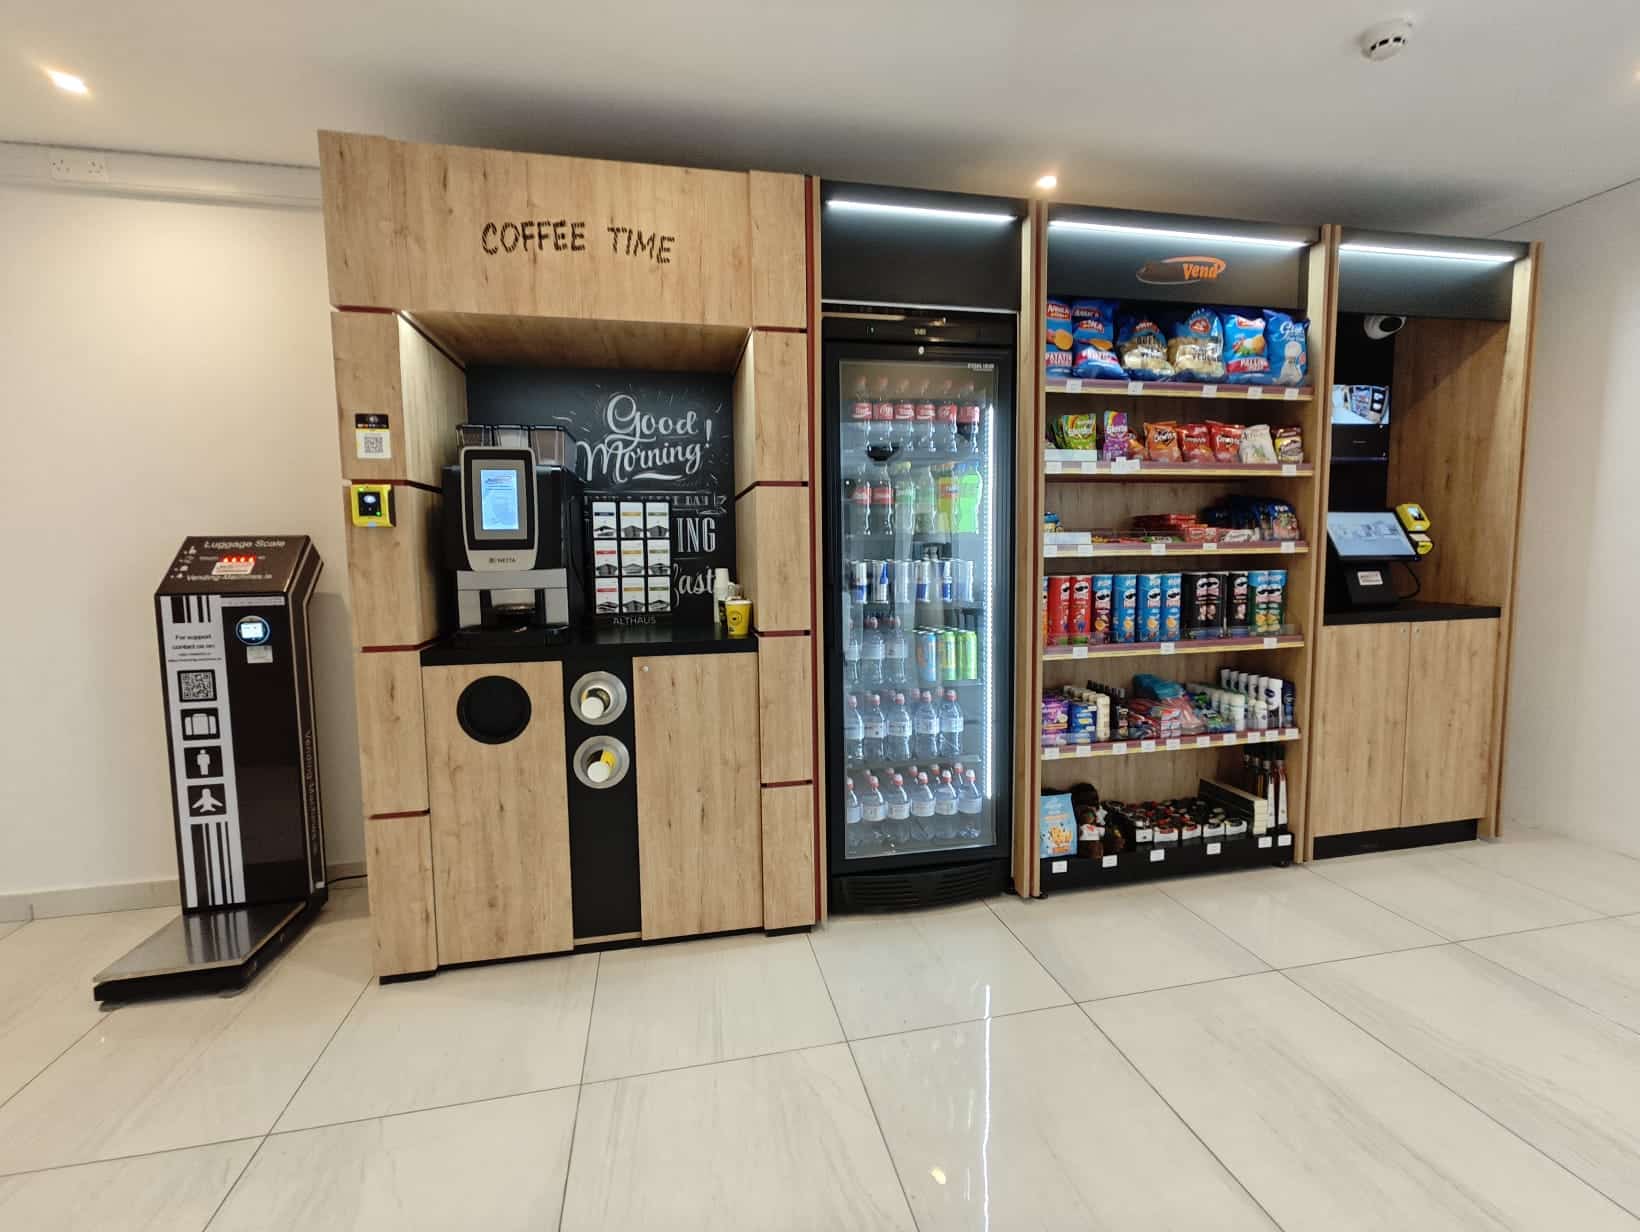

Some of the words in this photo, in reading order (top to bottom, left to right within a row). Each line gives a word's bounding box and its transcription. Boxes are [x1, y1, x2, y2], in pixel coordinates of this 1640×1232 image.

[481, 220, 586, 255] COFFEE
[607, 226, 676, 264] TIME
[1183, 262, 1217, 280] Vend
[606, 394, 699, 451] Good
[204, 540, 253, 550] Luggage
[255, 540, 286, 548] Scale
[613, 615, 657, 625] ALTHAUS
